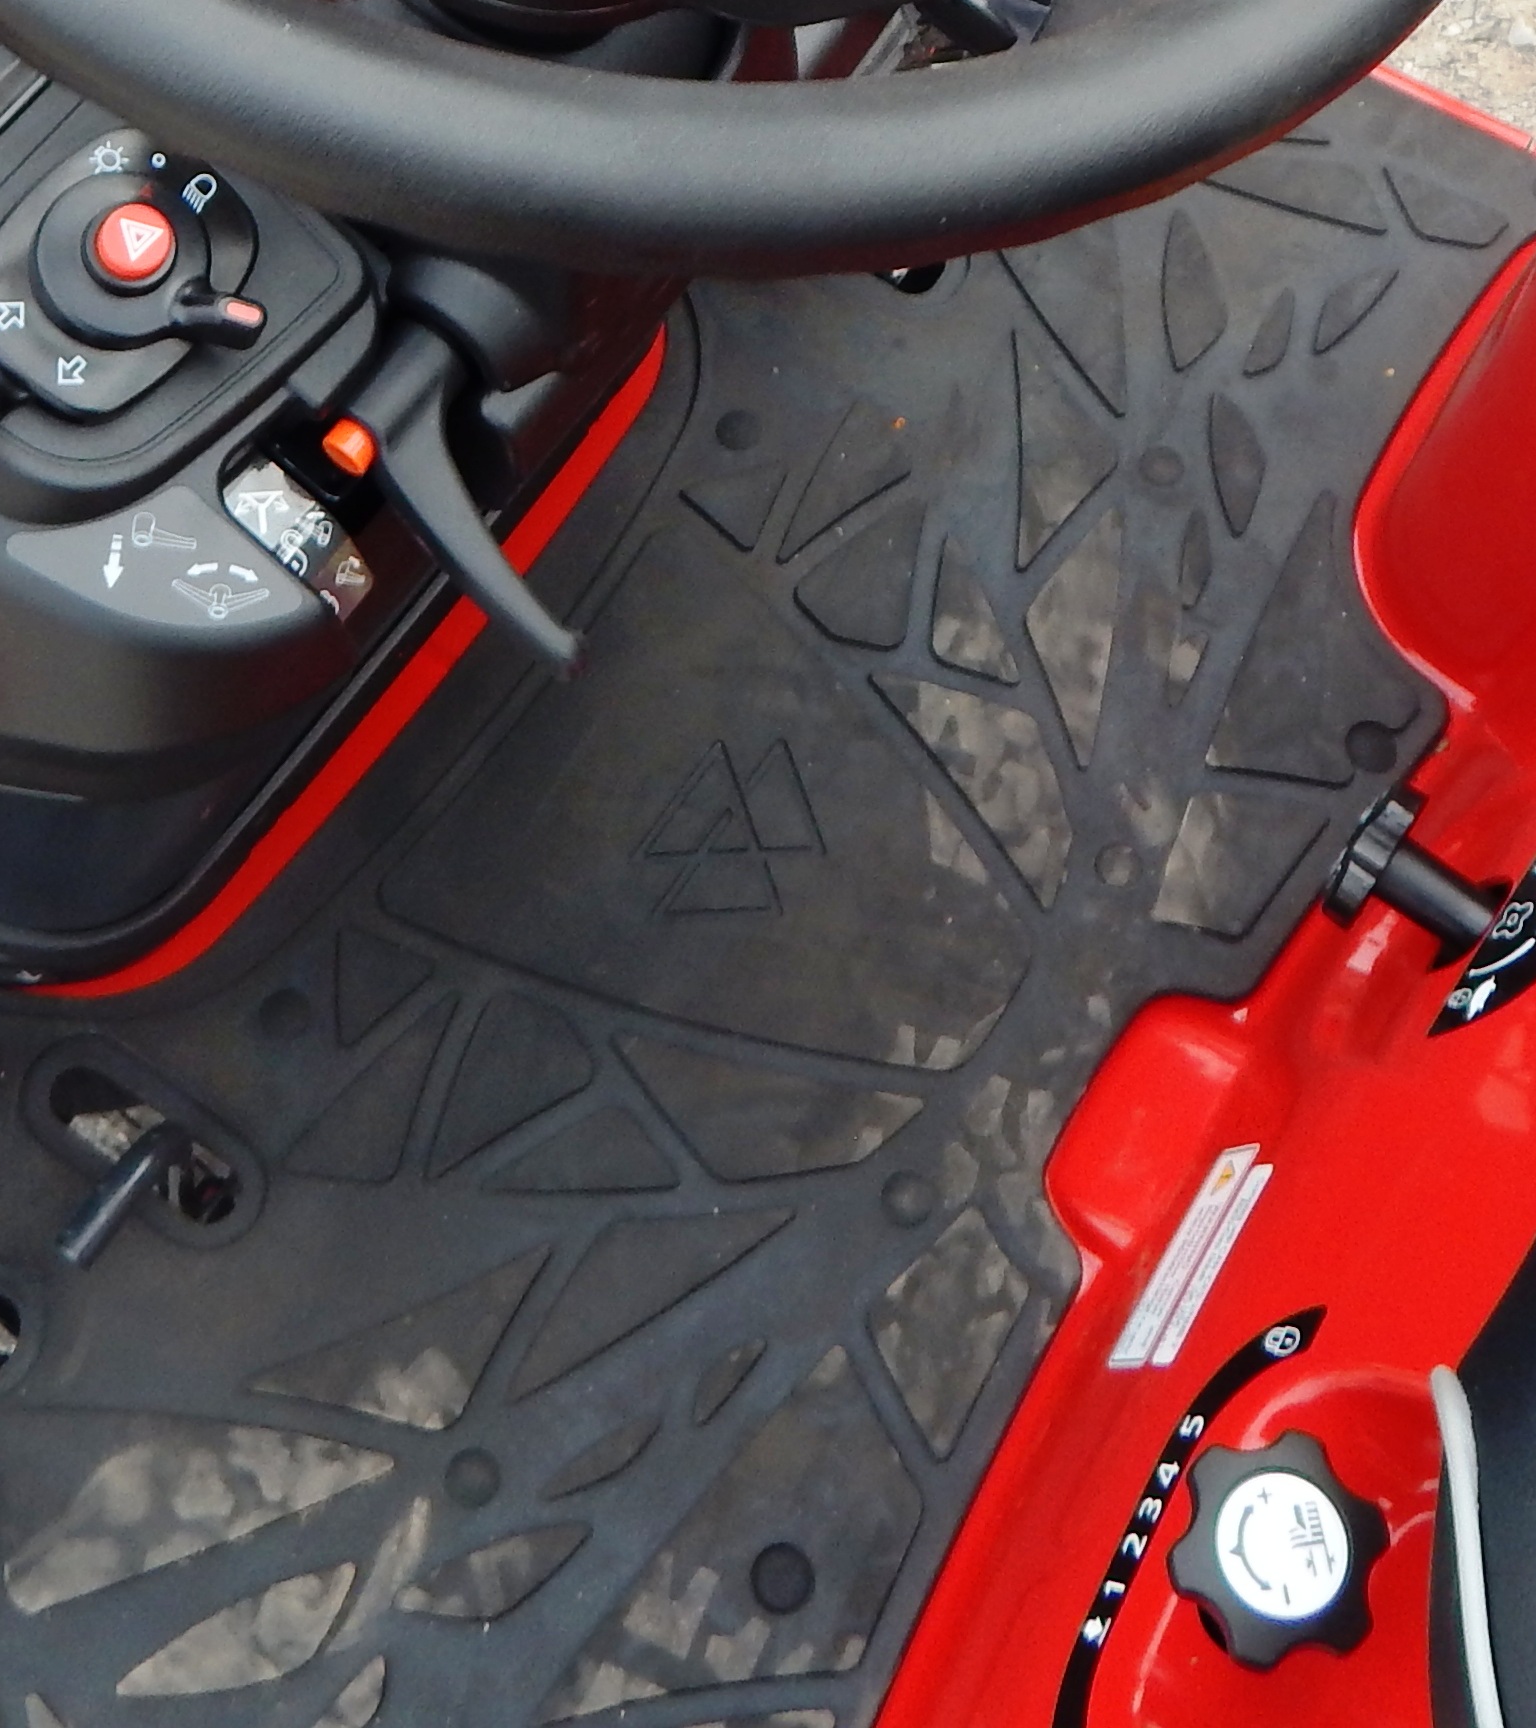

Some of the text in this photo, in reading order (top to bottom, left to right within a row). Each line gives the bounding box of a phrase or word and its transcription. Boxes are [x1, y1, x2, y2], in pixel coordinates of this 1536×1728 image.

[1122, 1532, 1148, 1560] 2
[1138, 1497, 1163, 1523] 3
[1156, 1461, 1180, 1489] 4
[1179, 1414, 1205, 1439] 5
